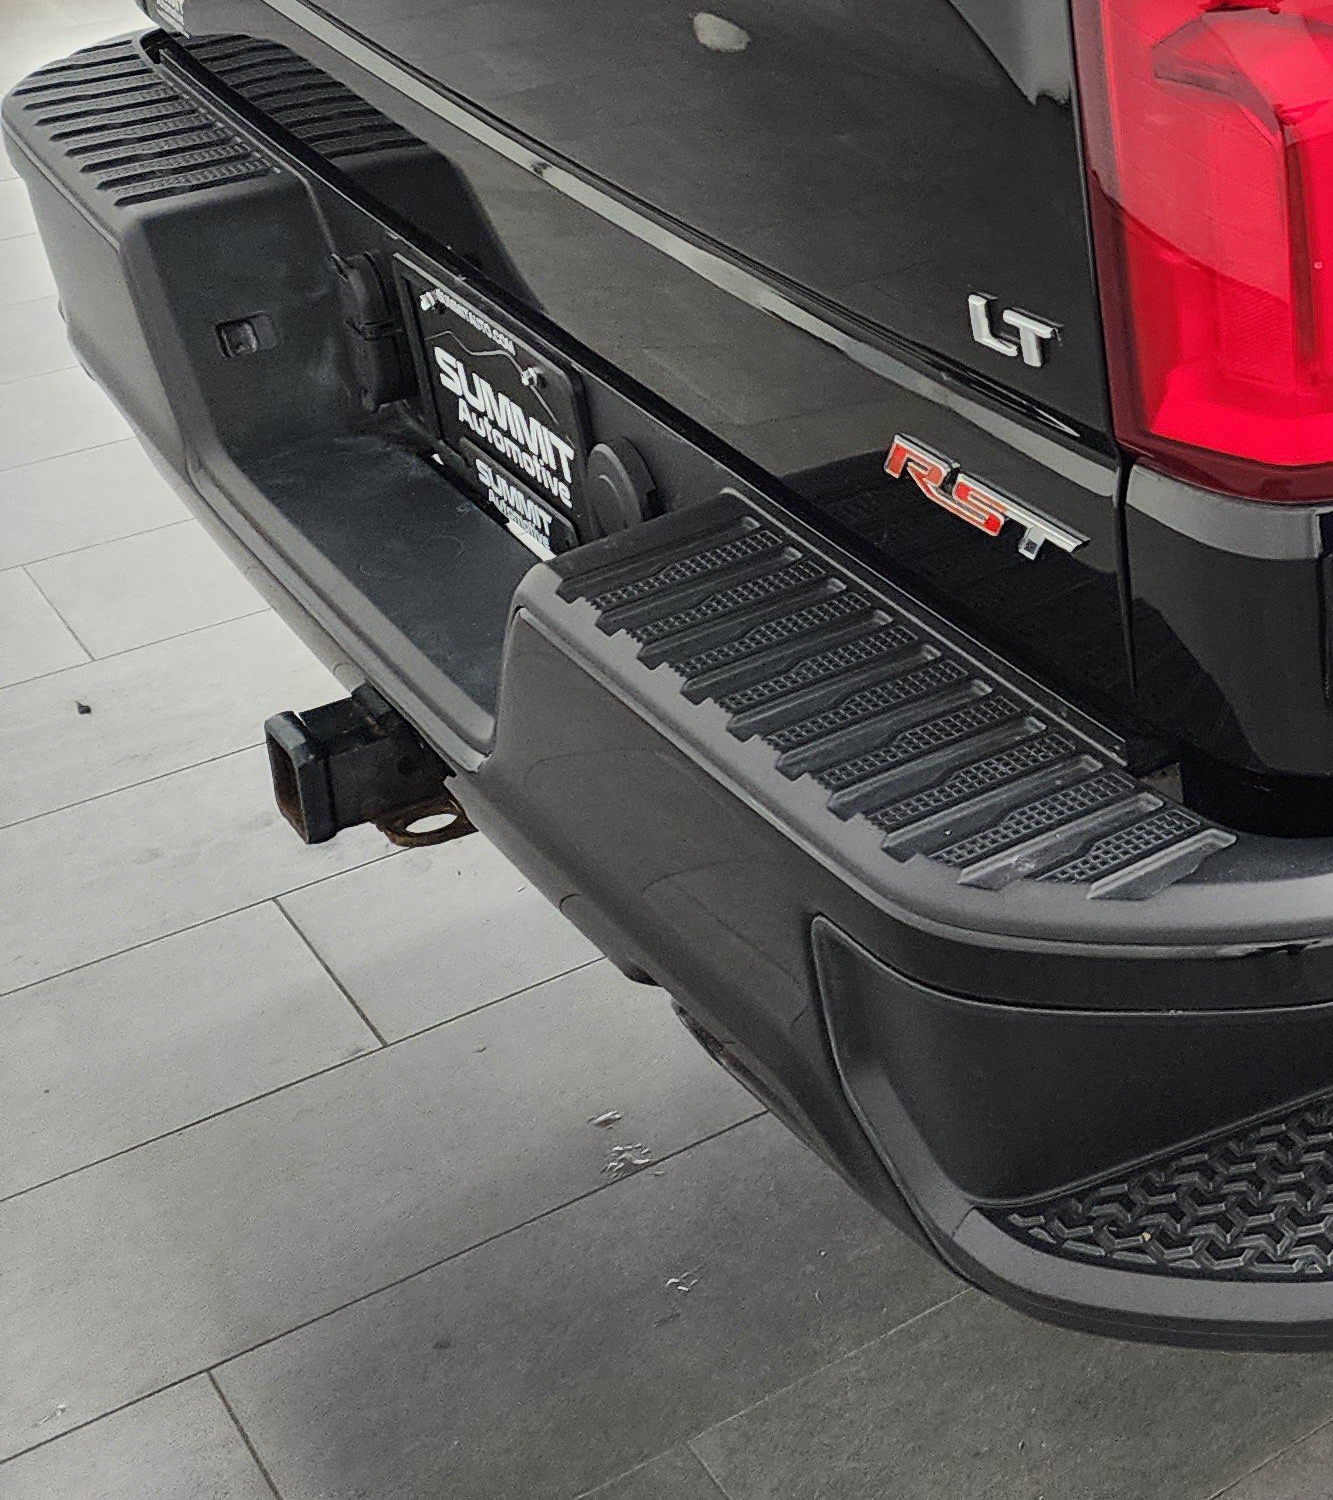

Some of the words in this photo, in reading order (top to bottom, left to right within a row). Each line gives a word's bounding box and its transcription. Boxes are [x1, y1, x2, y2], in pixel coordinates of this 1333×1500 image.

[967, 293, 1062, 368] LT
[434, 346, 575, 484] SUMMIT
[458, 398, 573, 509] Automotive
[475, 458, 552, 536] SUMMIT
[883, 434, 1090, 561] RST
